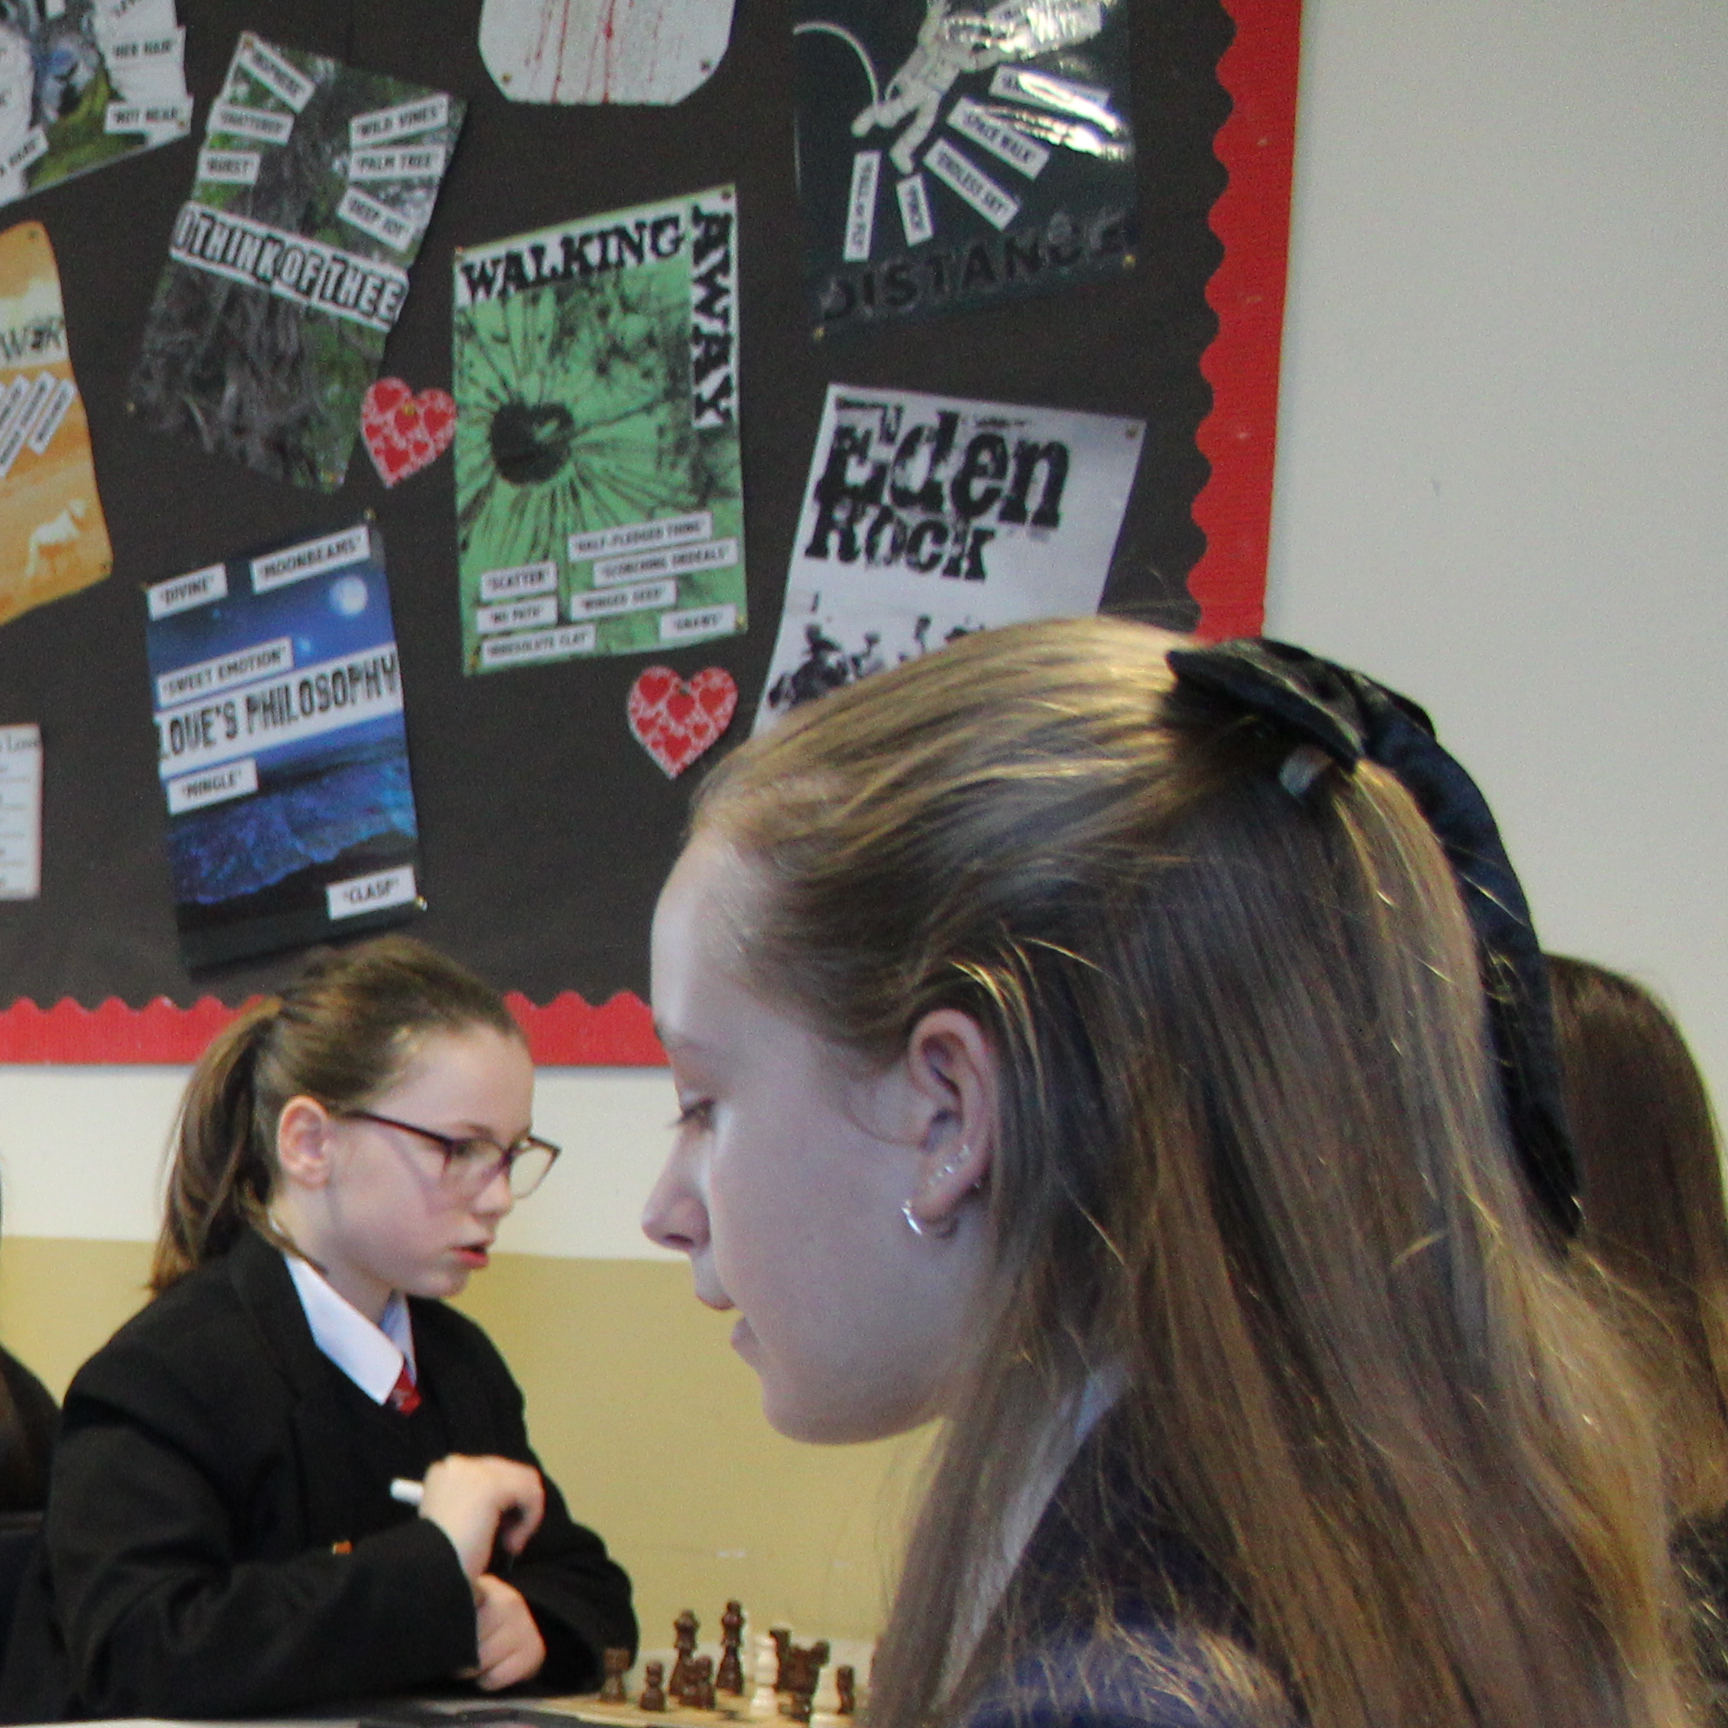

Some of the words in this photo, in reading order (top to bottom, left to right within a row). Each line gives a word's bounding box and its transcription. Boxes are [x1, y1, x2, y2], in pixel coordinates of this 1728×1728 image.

[189, 210, 285, 284] THINK
[280, 244, 323, 295] OF
[317, 252, 404, 324] THEE
[461, 215, 684, 301] WALKING
[690, 204, 733, 429] AWAY
[814, 397, 1071, 527] Eden
[805, 487, 997, 582] Rock
[245, 650, 399, 735] PHILOSOPHY
